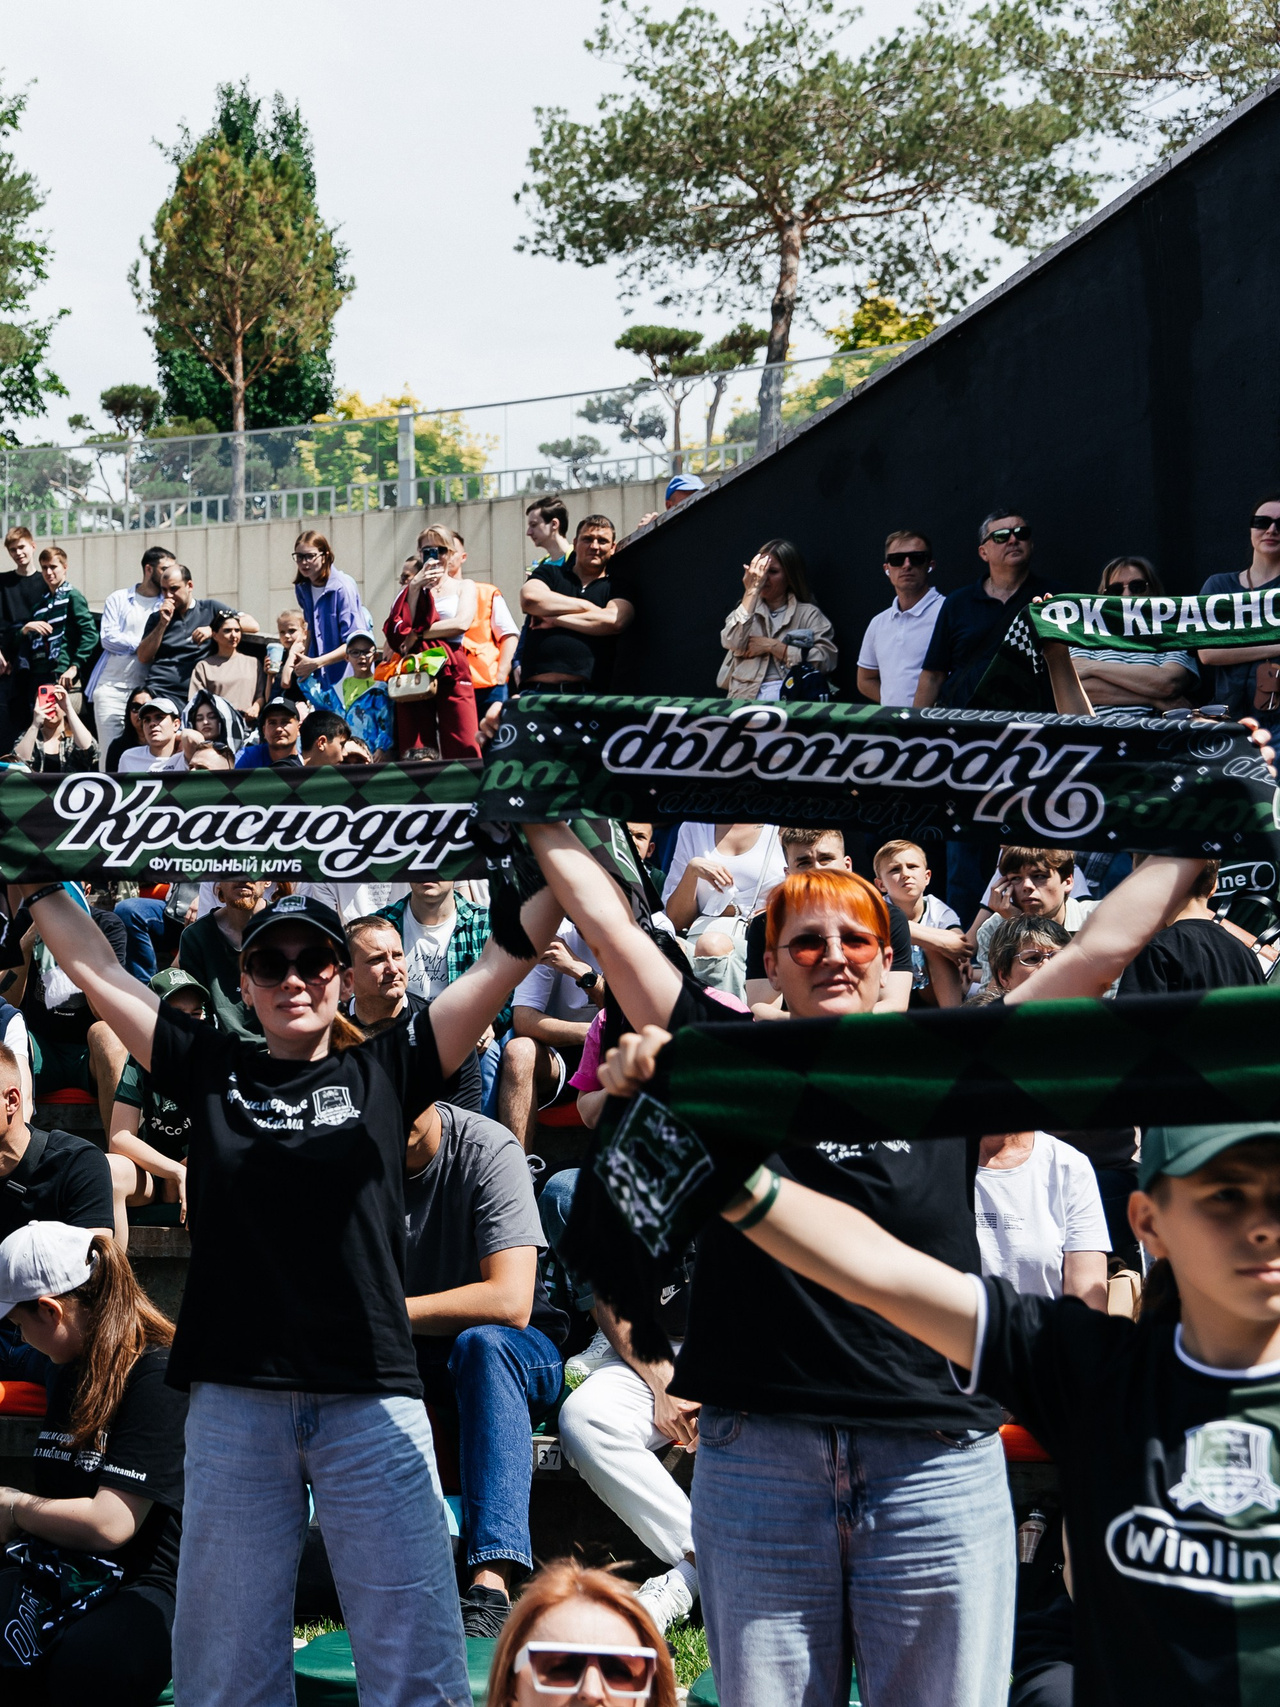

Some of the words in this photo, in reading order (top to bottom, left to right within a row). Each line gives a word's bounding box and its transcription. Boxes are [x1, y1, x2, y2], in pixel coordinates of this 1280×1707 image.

[1041, 598, 1111, 636] ФК
[601, 705, 1105, 839] Краснодар
[52, 772, 476, 878] Краснодар
[149, 856, 258, 874] ФУТБОЛЬНЫЙ
[261, 858, 302, 874] КЛУБ
[540, 1450, 559, 1466] 37
[1126, 1523, 1280, 1581] Winlin
